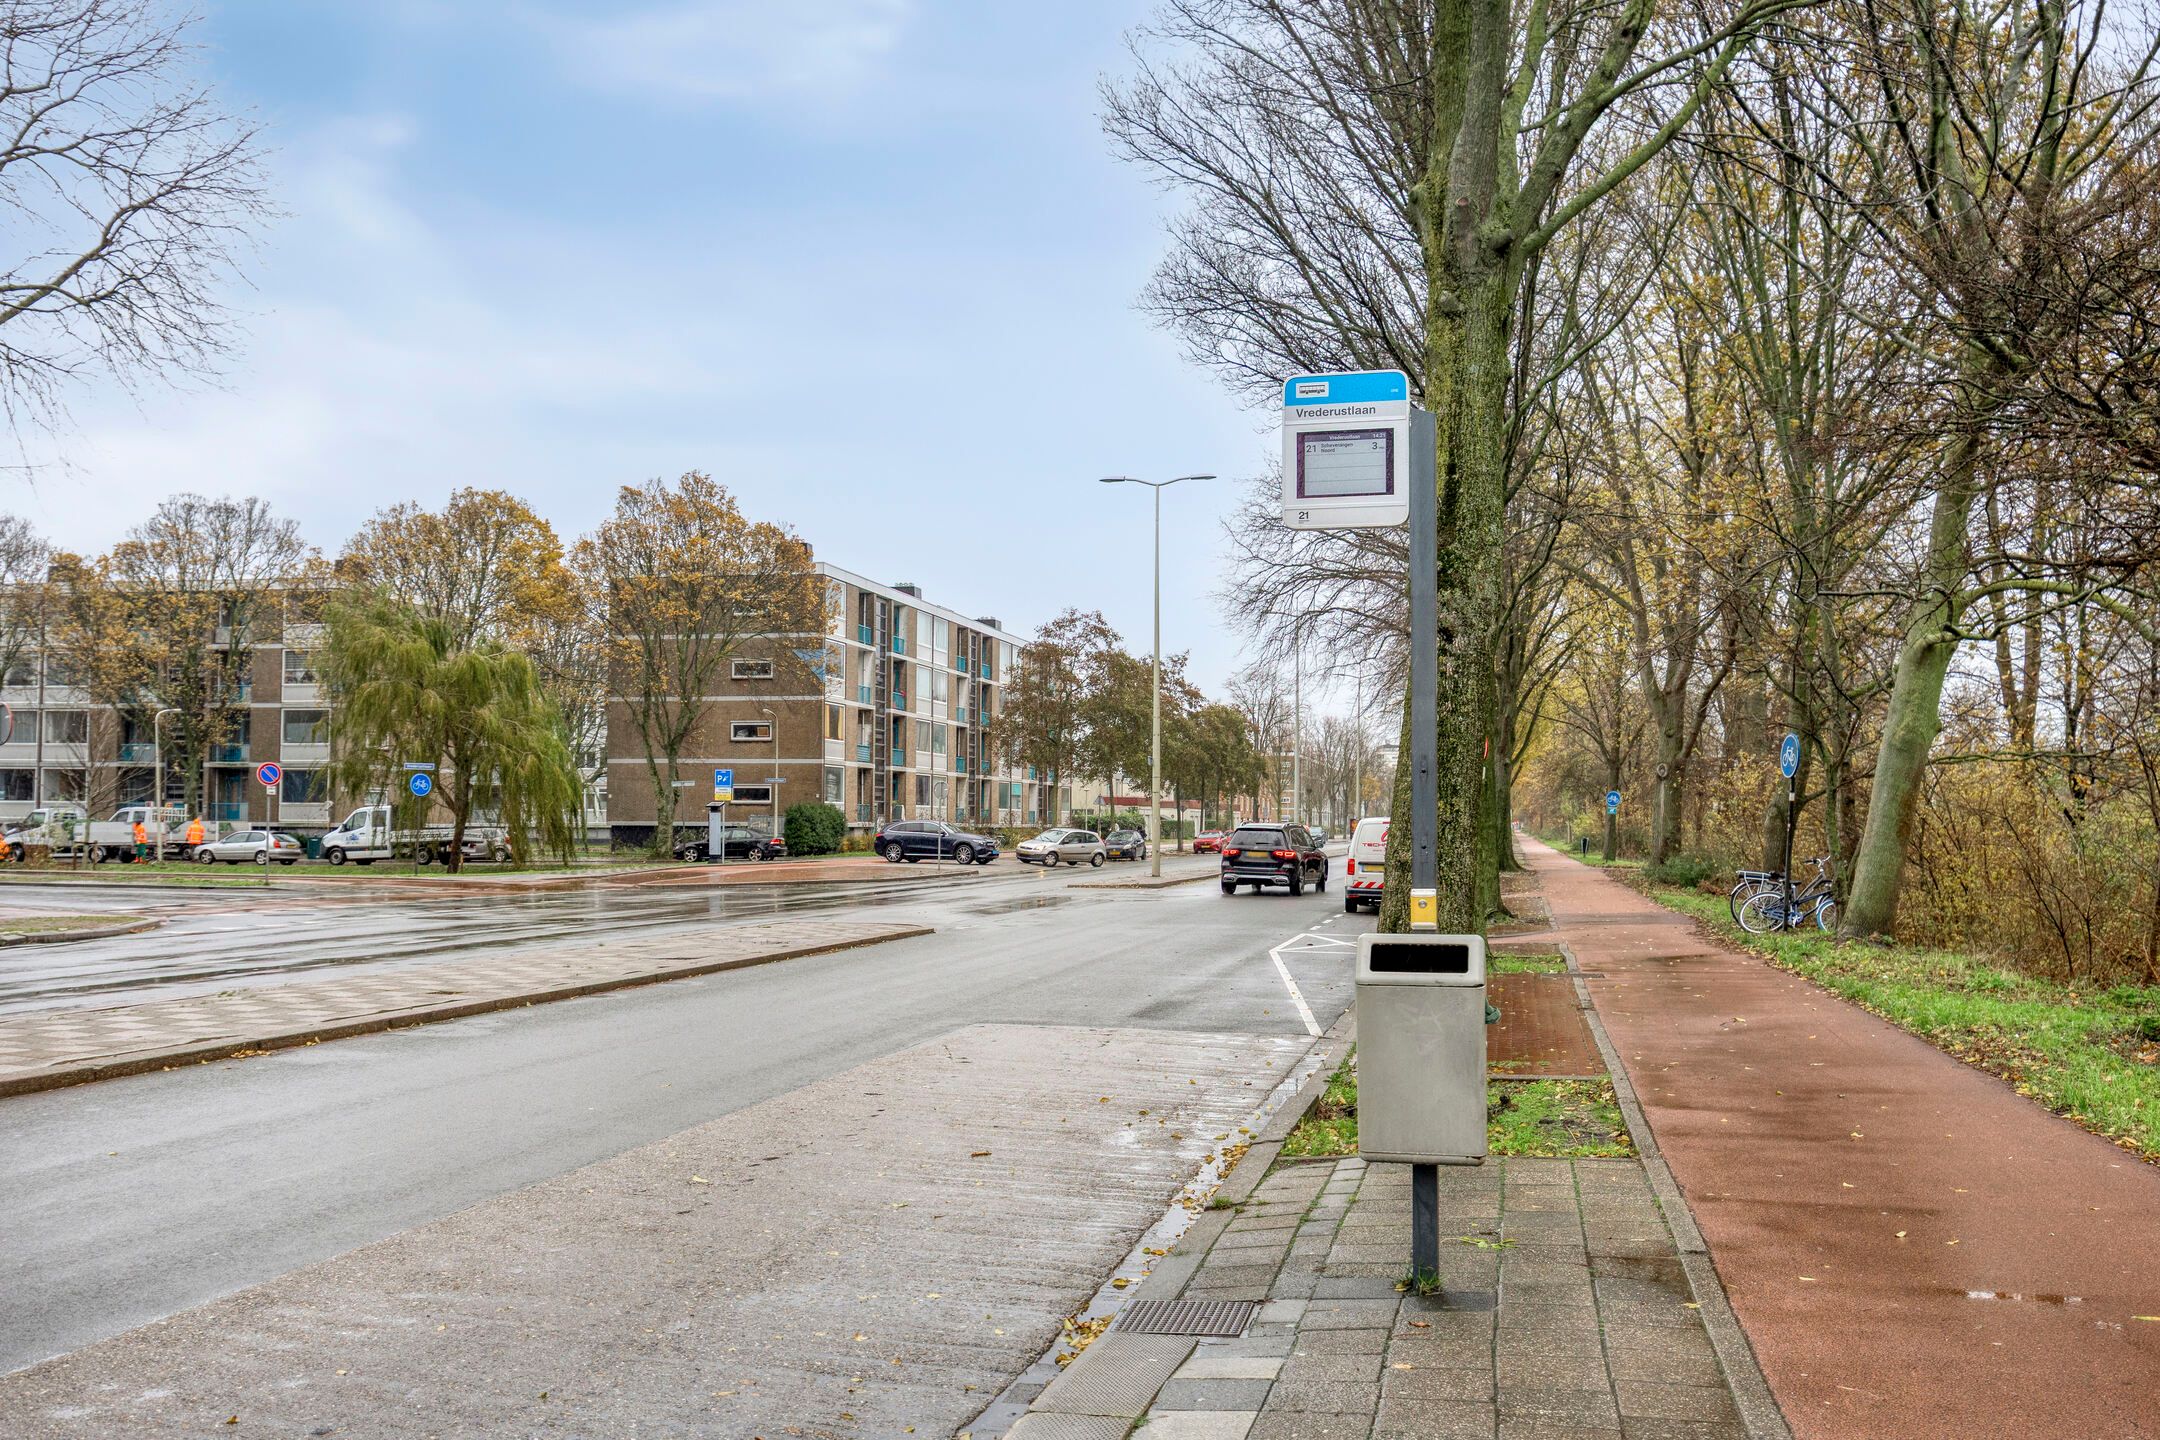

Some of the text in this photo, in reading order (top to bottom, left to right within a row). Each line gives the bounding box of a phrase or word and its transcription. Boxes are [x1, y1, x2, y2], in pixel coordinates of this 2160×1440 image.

[1296, 406, 1376, 418] Vrederustlaan
[1306, 444, 1317, 453] 21
[1372, 441, 1378, 450] 3
[1298, 512, 1308, 520] 21
[717, 775, 723, 783] P
